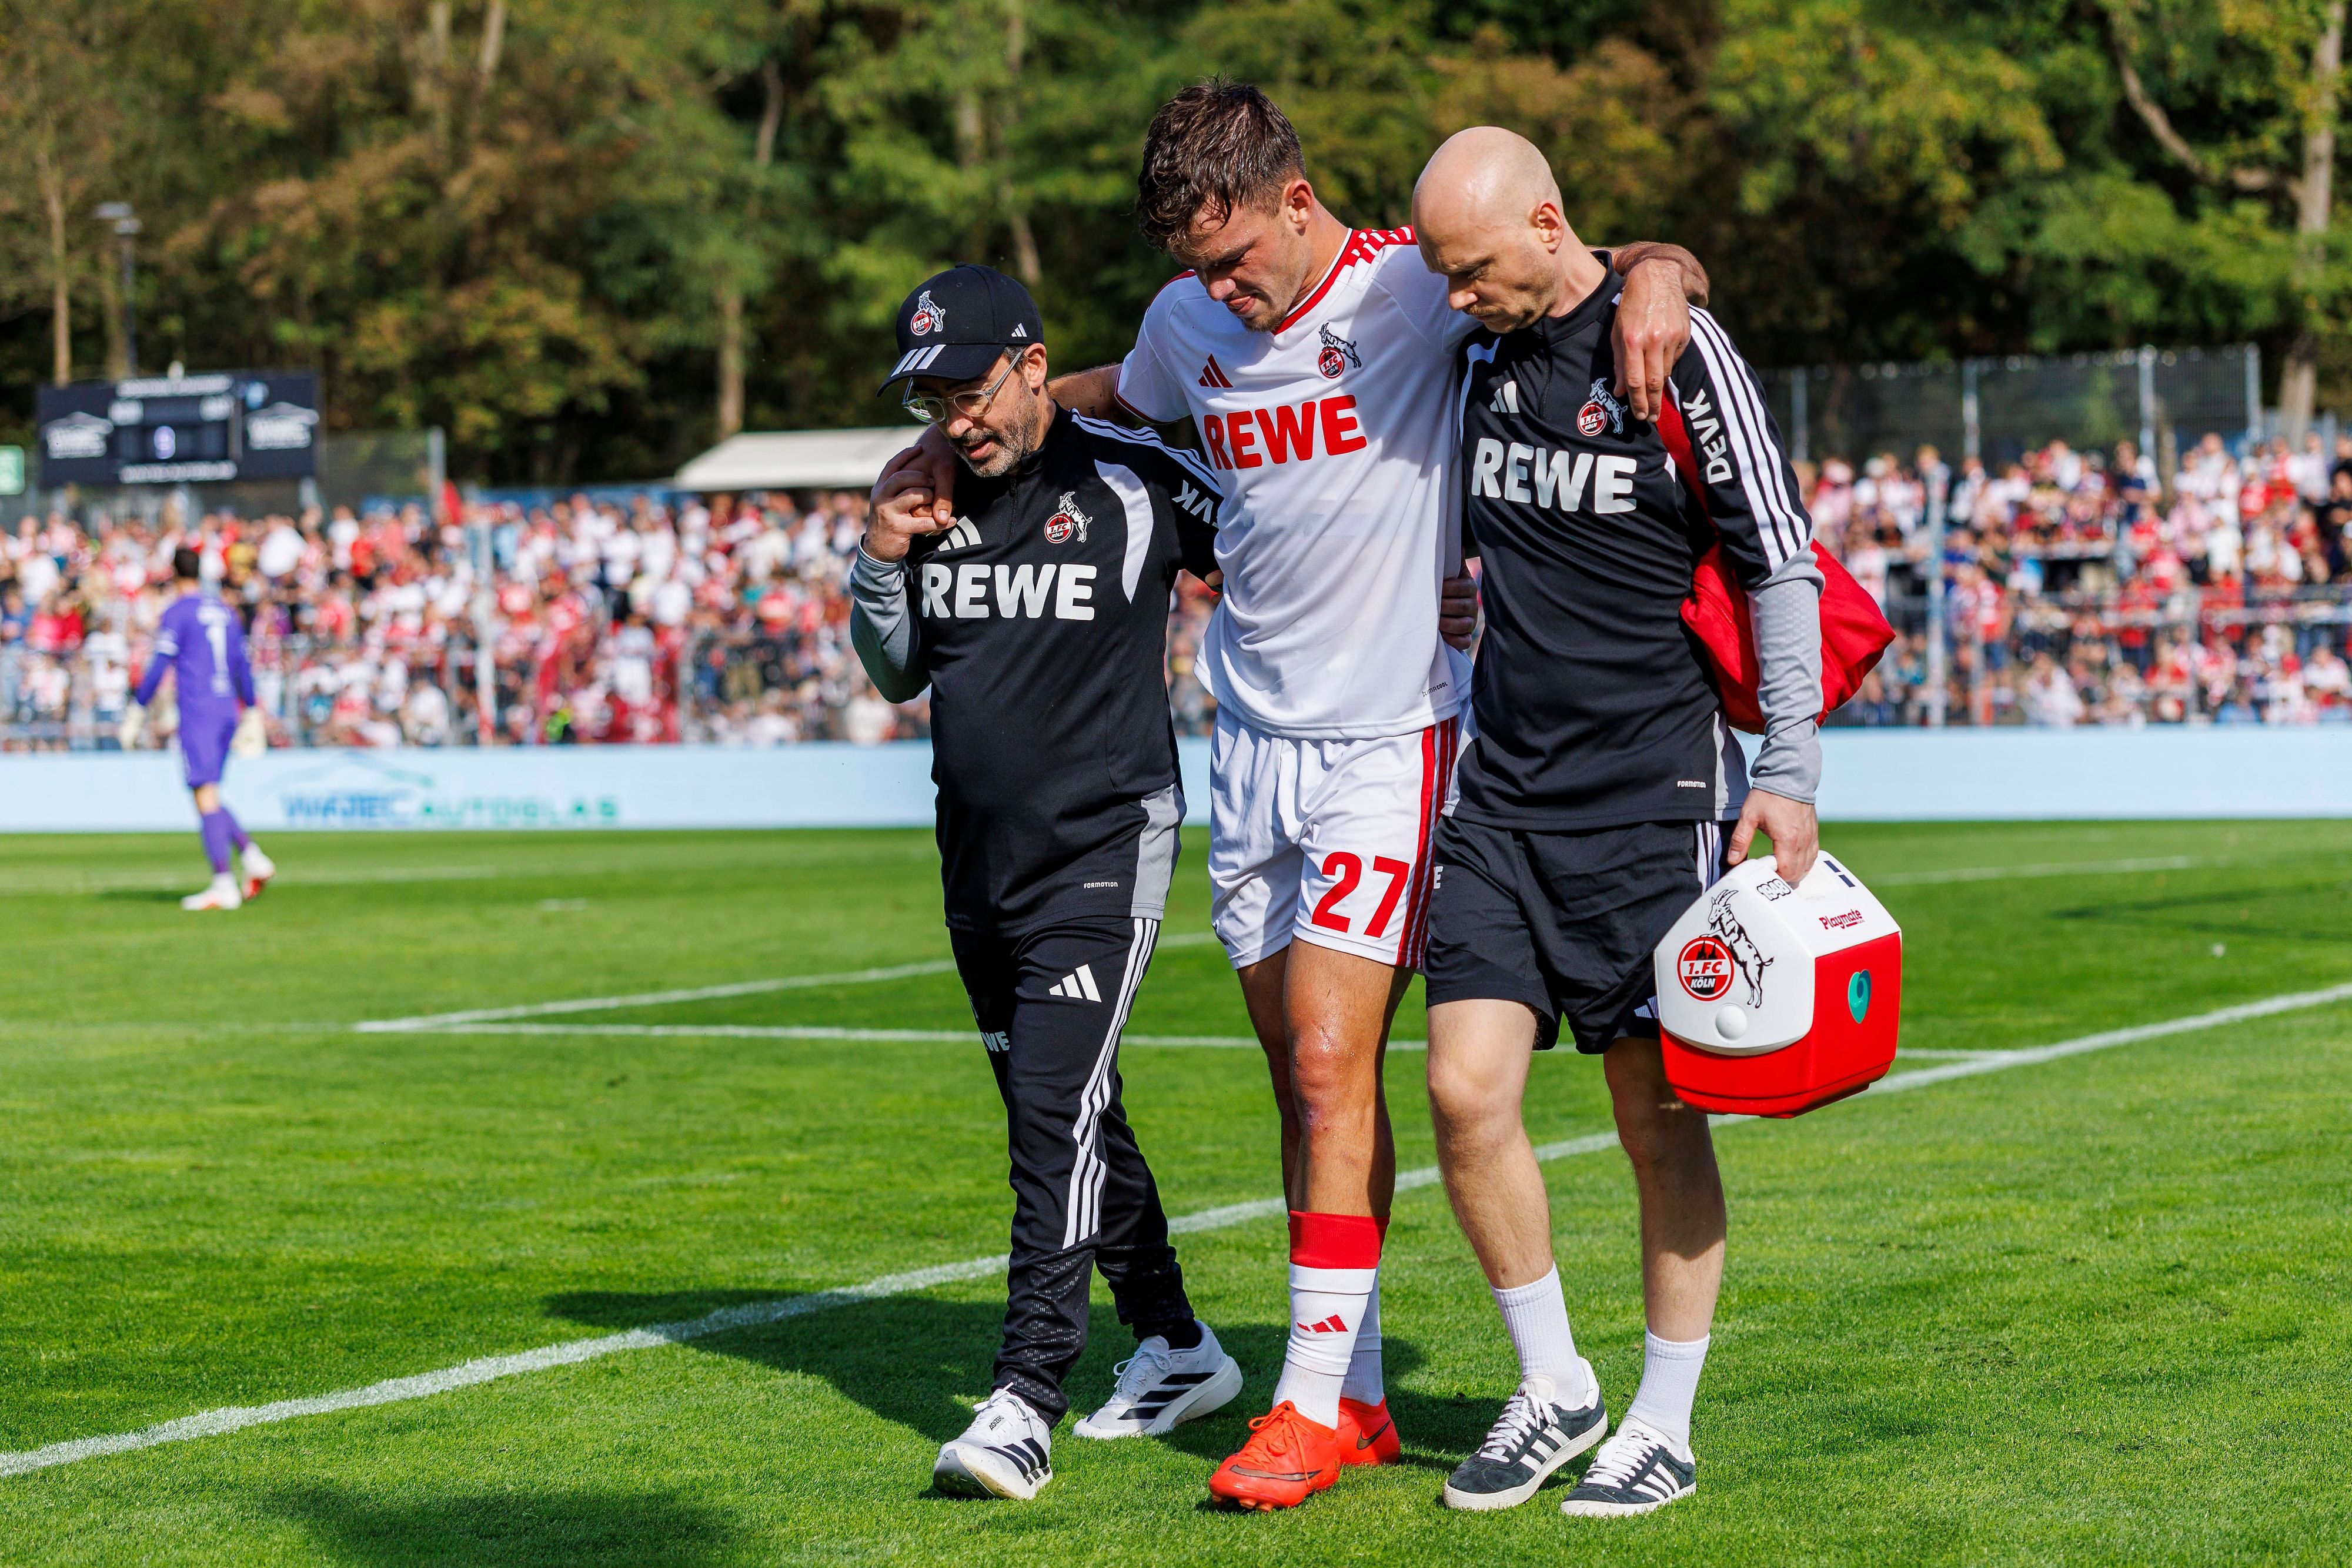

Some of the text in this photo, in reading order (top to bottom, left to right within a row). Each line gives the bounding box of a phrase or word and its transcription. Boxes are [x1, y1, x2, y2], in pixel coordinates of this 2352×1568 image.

[1583, 413, 1601, 424] 1.FC
[1203, 394, 1367, 470] REWE
[1682, 388, 1733, 484] DEVK
[1471, 437, 1638, 514] REWE
[1171, 479, 1220, 529] VK
[1051, 523, 1068, 533] 1.FC
[922, 563, 1097, 621] REWE
[1311, 851, 1410, 938] 27
[1757, 878, 1791, 901] 1948
[1819, 909, 1862, 930] Playmate
[1689, 961, 1722, 975] 1.FC
[1690, 977, 1716, 988] KÖLN
[981, 1031, 1010, 1052] WE
